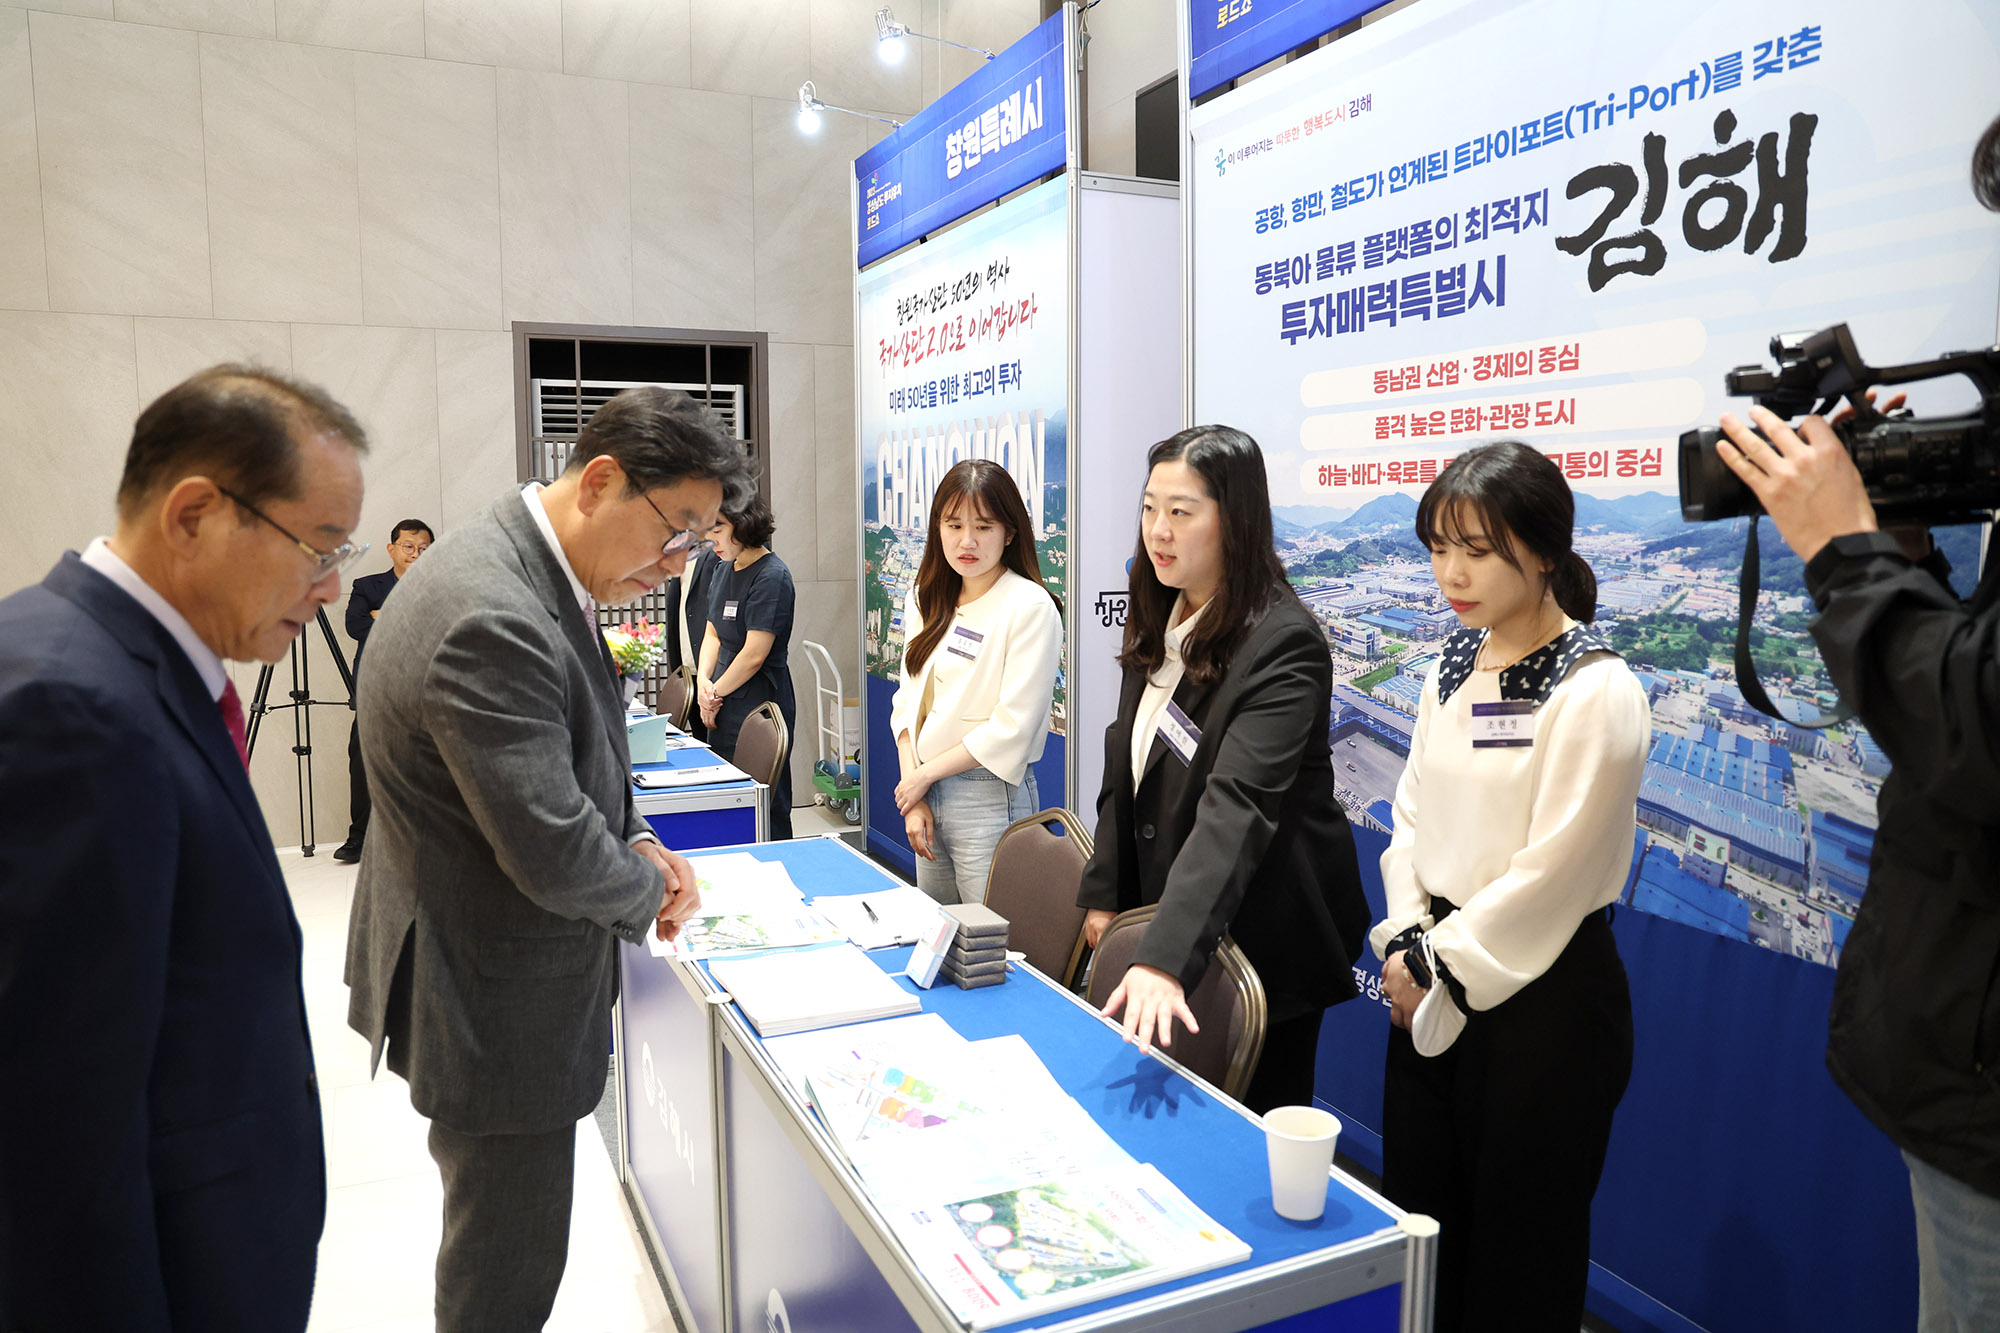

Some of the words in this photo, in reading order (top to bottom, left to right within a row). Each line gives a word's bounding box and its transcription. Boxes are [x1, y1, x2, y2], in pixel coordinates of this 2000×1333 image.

[1217, 0, 1253, 29] 로드쇼
[945, 76, 1043, 180] 창원특례시
[1237, 138, 1273, 161] 이루어지는
[1275, 126, 1300, 147] 따뜻한
[1303, 104, 1346, 136] 행복도시
[1349, 93, 1372, 118] 김해
[1255, 204, 1288, 234] 공항,
[1291, 190, 1327, 223] 항만,
[1331, 171, 1384, 211] 철도가
[1388, 150, 1448, 194] 연계된
[1454, 50, 1743, 174] 트라이포트(Tri-Port)를
[1753, 25, 1822, 81] 갖춘
[1555, 108, 1818, 293] 김해
[1254, 253, 1311, 295] 동북아
[1316, 240, 1356, 281] 물류
[1362, 213, 1458, 269] 플랫폼의
[1464, 188, 1549, 243] 최적지
[951, 271, 982, 305] 50년의
[987, 256, 1010, 293] 역사
[1280, 254, 1506, 346] 투자매력특별시
[969, 292, 1038, 342] 이어갑니다
[889, 388, 905, 415] 미래
[907, 380, 938, 409] 50년을
[939, 373, 960, 405] 위한
[963, 367, 995, 400] 최고의
[998, 359, 1022, 392] 투자
[1373, 365, 1421, 394] 동남권
[1538, 343, 1580, 372] 중심
[1374, 414, 1406, 440] 품격
[1410, 410, 1446, 437] 높은
[1535, 398, 1576, 427] 도시
[1615, 447, 1662, 477] 중심
